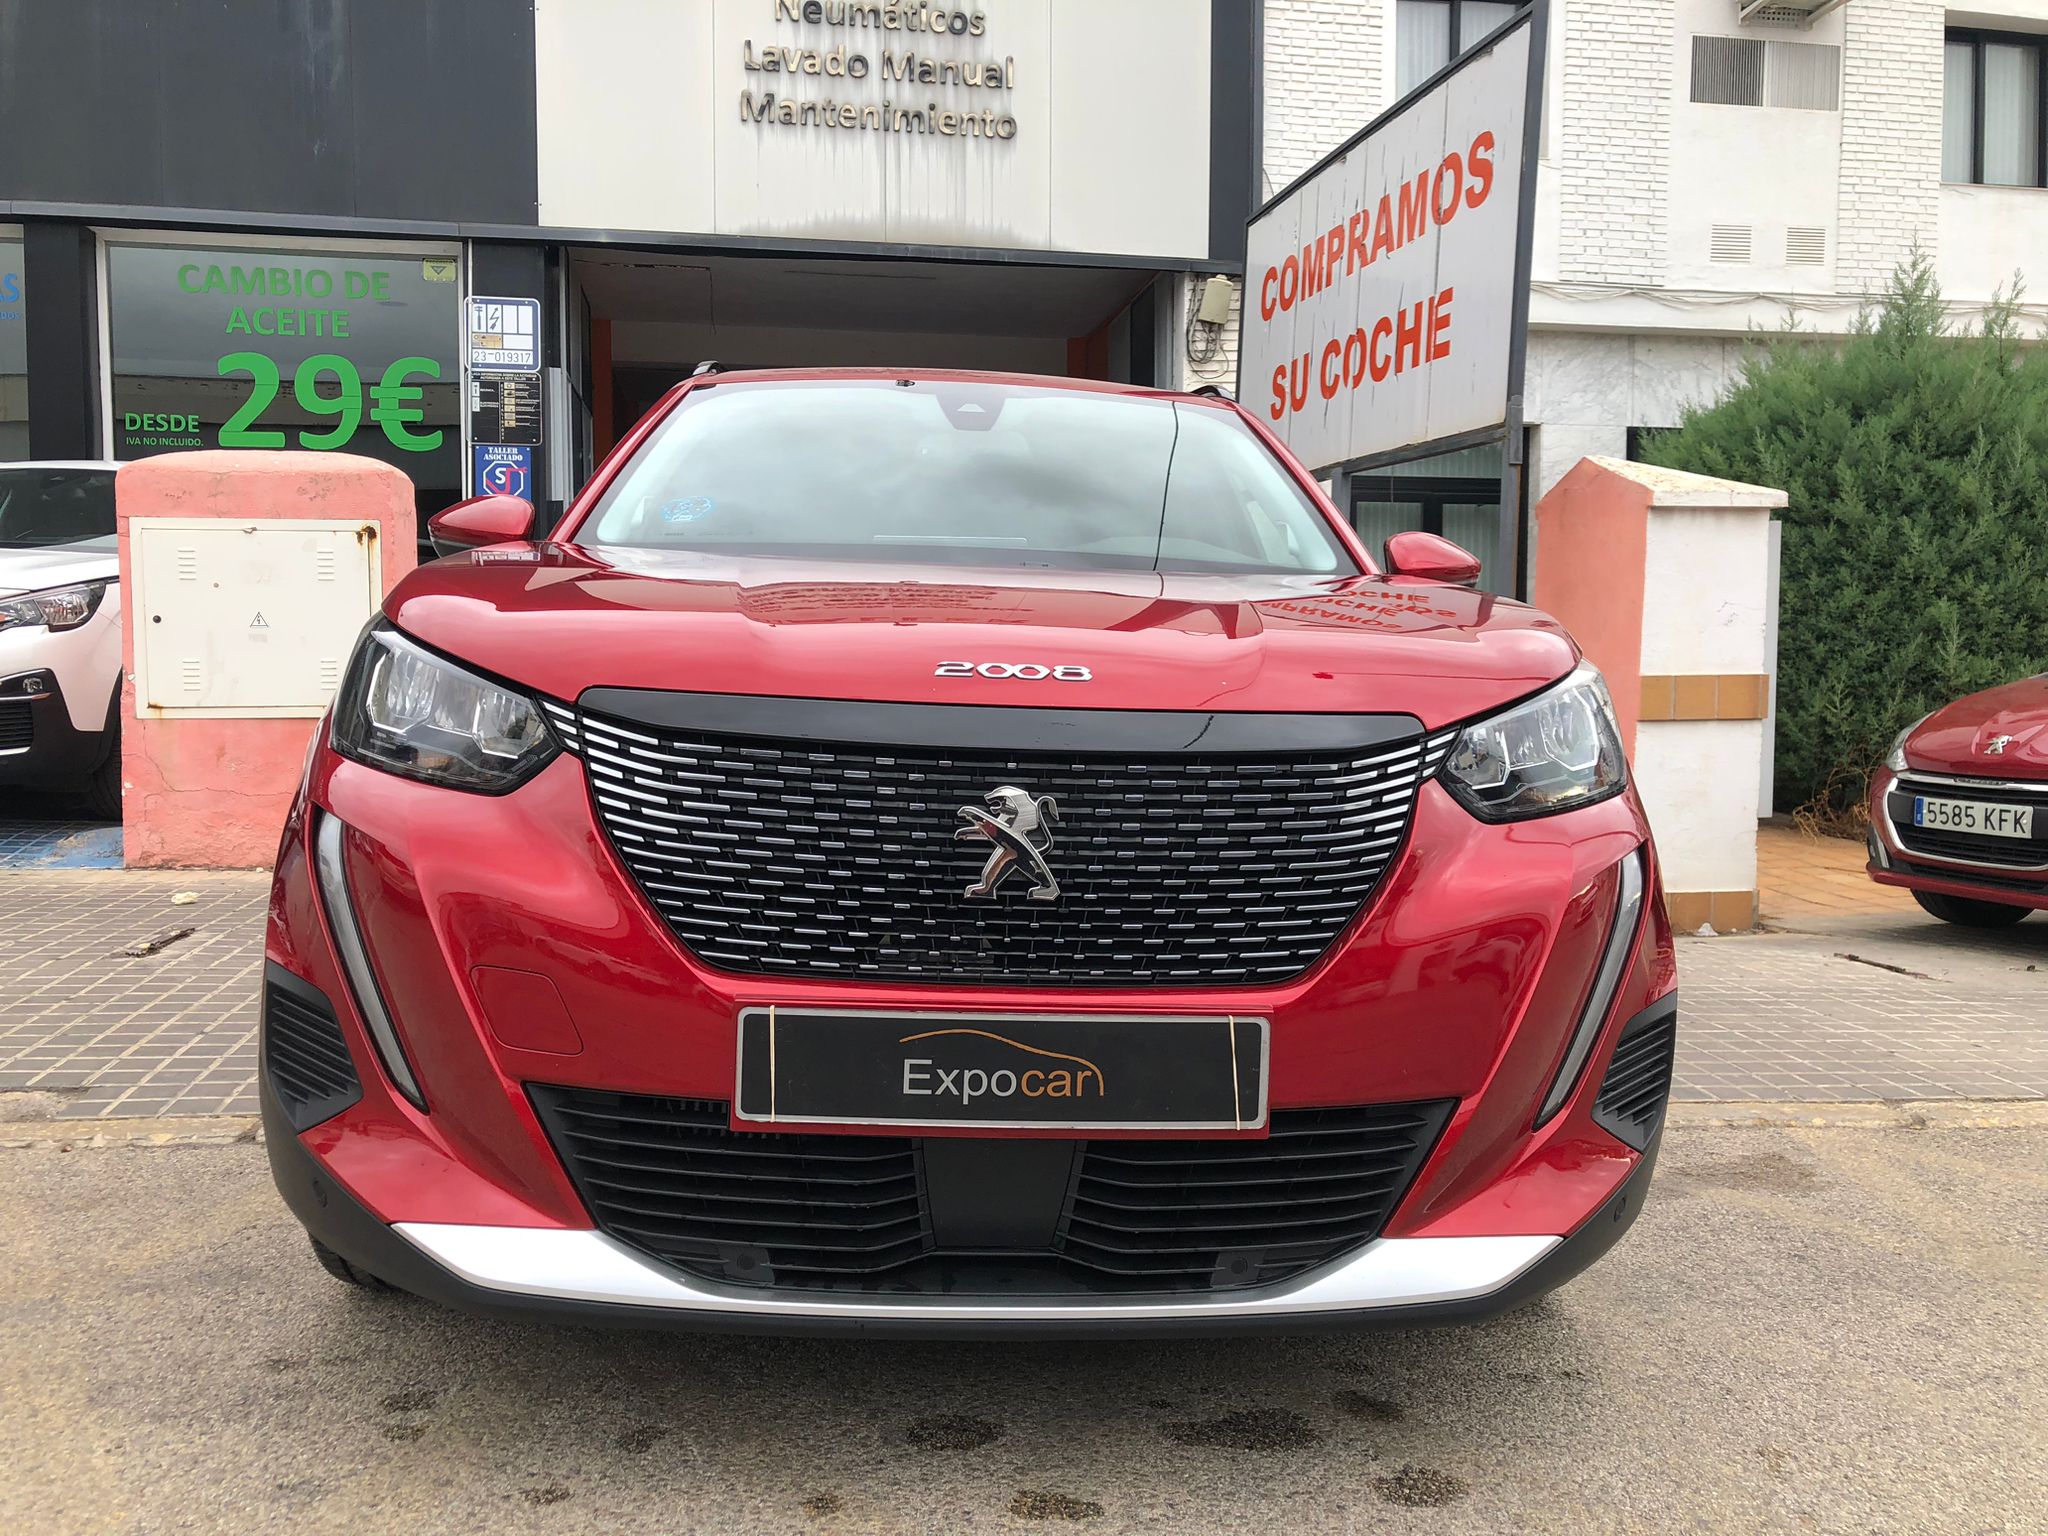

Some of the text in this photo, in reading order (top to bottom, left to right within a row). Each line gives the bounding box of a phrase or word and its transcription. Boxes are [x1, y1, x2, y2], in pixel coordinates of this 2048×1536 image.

[774, 0, 985, 36] Neumáticos
[743, 39, 1014, 89] Lavado Manual
[740, 88, 1017, 139] Mantenimiento
[1261, 130, 1495, 322] COMPRAMOS
[177, 264, 390, 300] CAMBIO DE
[225, 306, 351, 338] ACEITE
[1270, 286, 1454, 420] SU COCHE
[217, 352, 443, 451] 29€
[125, 412, 200, 433] DESDE
[126, 437, 204, 447] IVA NO INCLUIDO.
[483, 453, 523, 461] ASOCIADO
[487, 446, 518, 454] TALLER
[934, 661, 1093, 682] 2008
[1927, 801, 2027, 834] 5585 KFK
[903, 1058, 1092, 1106] Expocar
